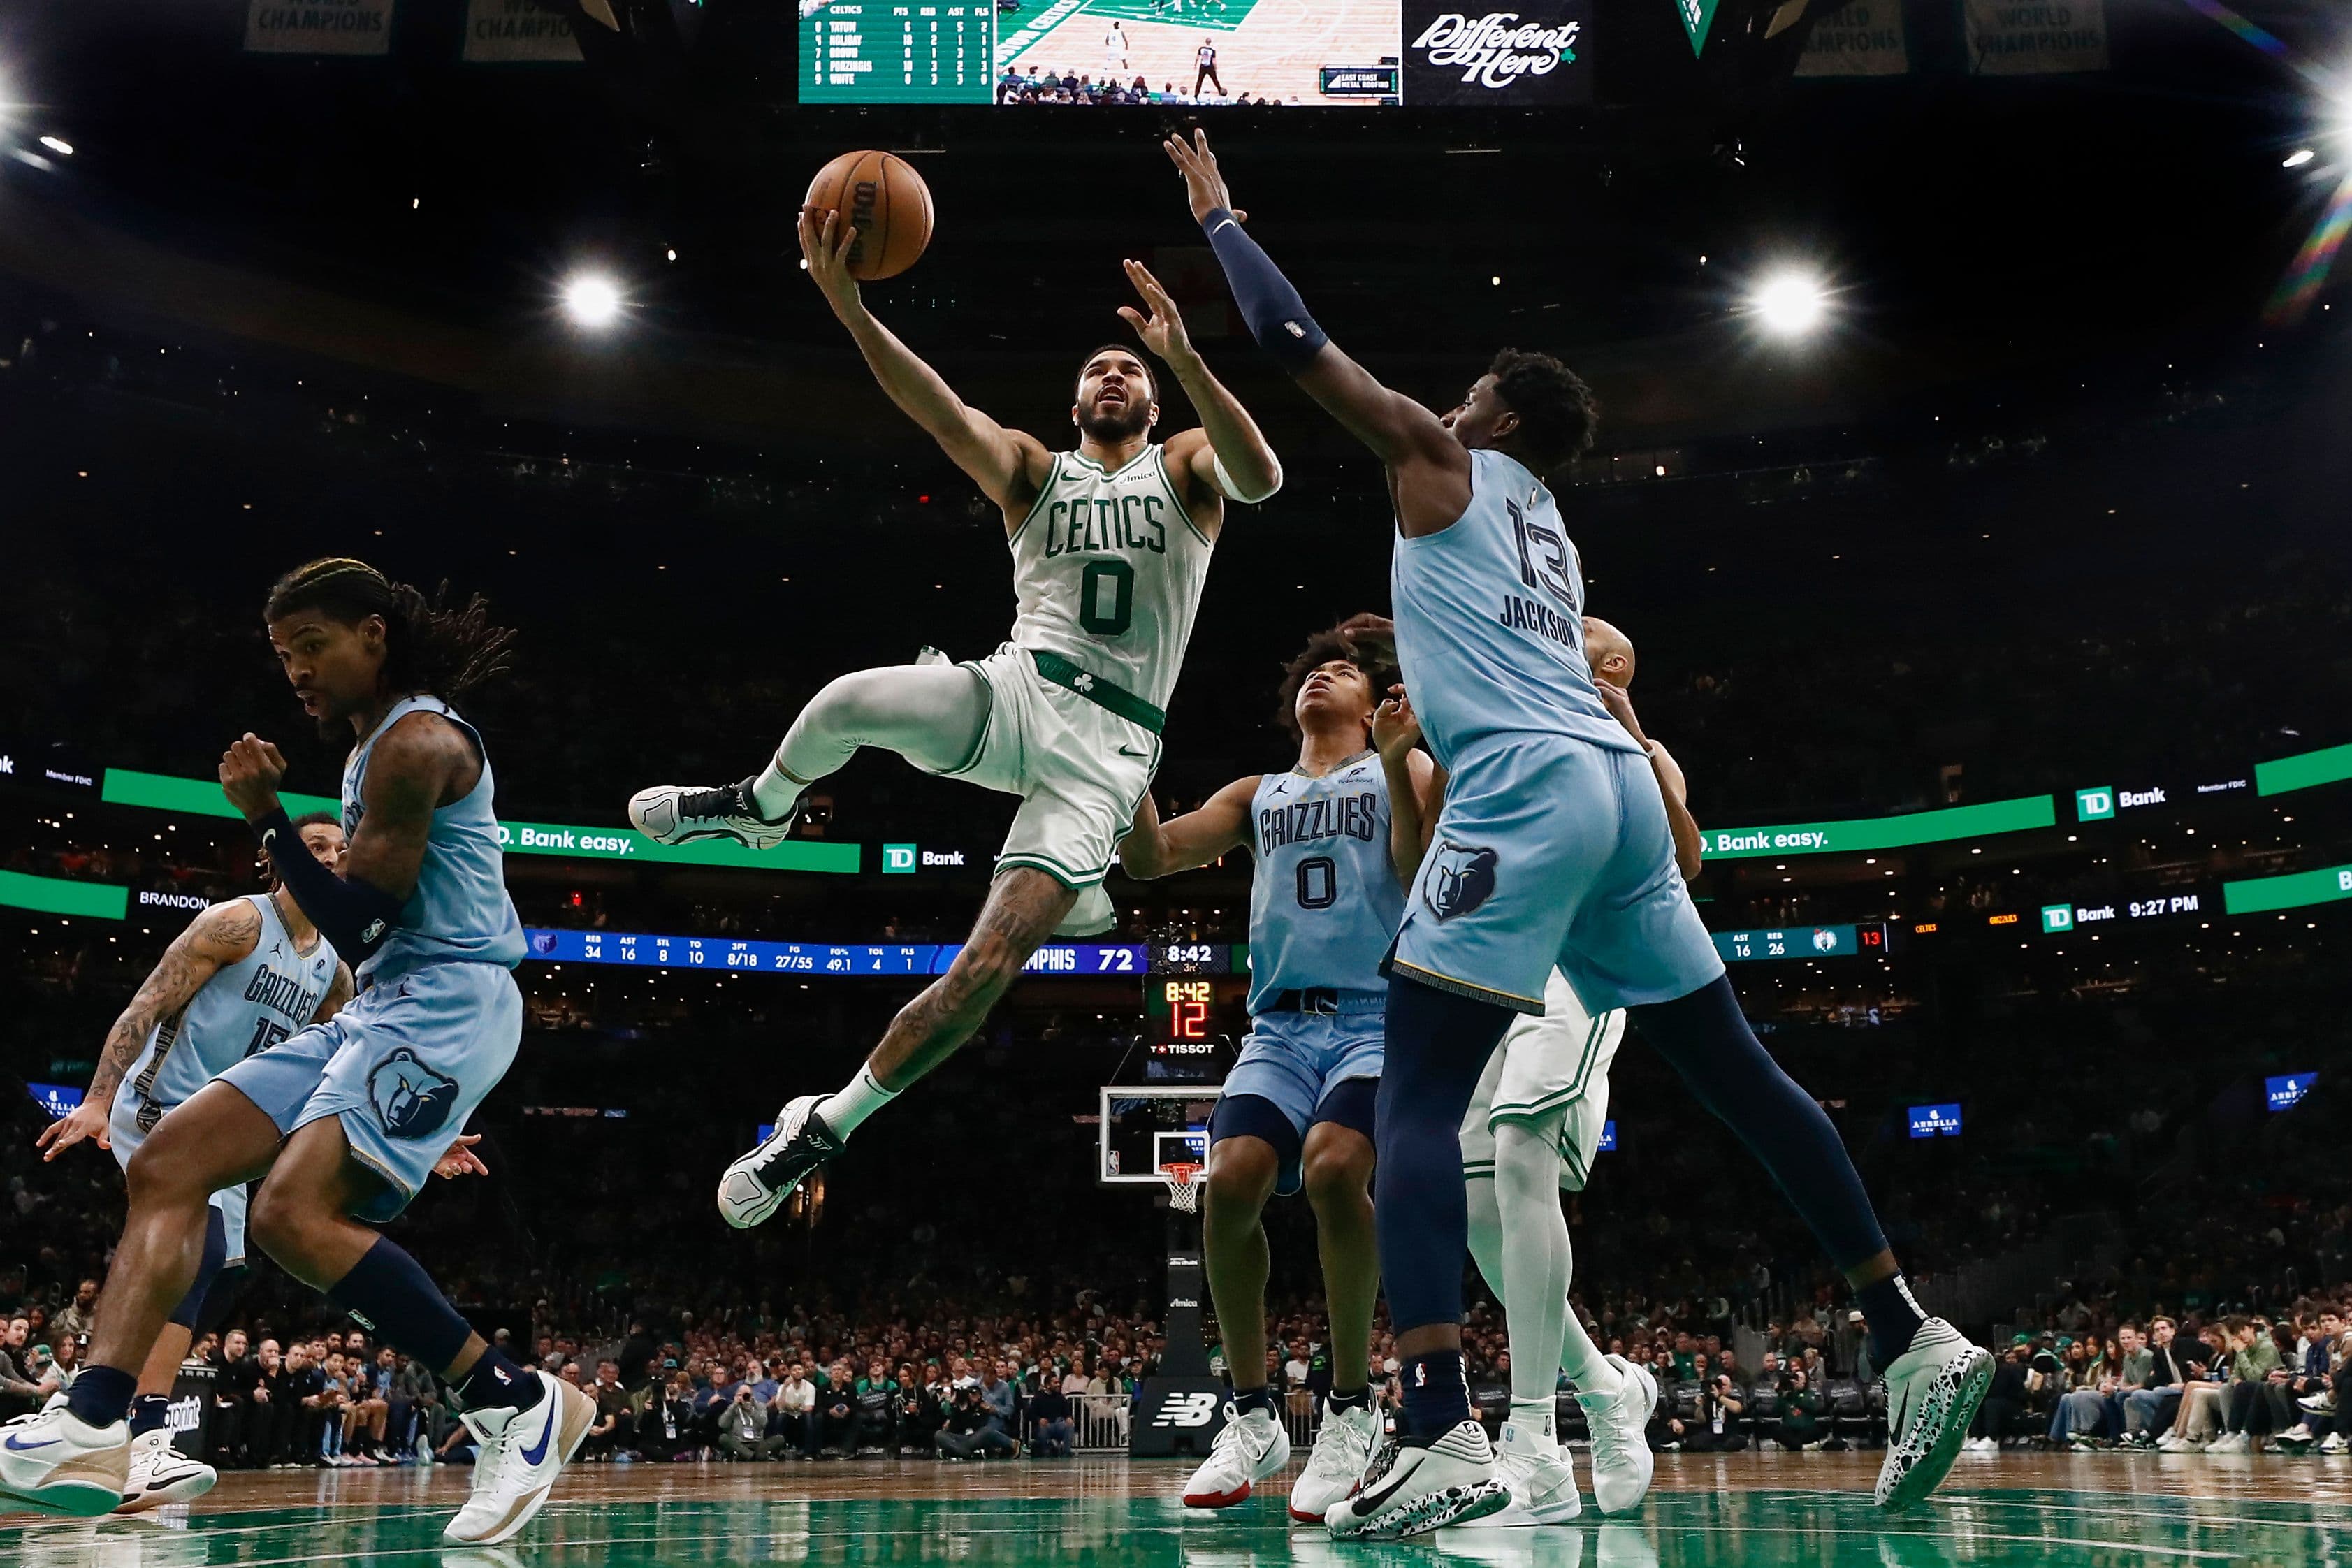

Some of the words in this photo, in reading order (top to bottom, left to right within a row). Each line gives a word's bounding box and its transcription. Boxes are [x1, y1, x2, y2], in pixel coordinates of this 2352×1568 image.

[258, 8, 382, 32] CHAMPIONS
[829, 5, 862, 15] CELTICS
[893, 7, 909, 17] PTS
[920, 7, 936, 17] REB
[947, 7, 964, 17] AST
[974, 7, 989, 17] FLS
[829, 20, 857, 33] TATUM
[957, 20, 964, 33] 5
[980, 20, 988, 33] 2
[1411, 13, 1581, 56] Different
[930, 34, 938, 46] 2
[957, 34, 963, 46] 1
[815, 47, 822, 59] 7
[931, 47, 937, 59] 1
[957, 47, 964, 59] 3
[982, 47, 987, 59] 1
[931, 60, 938, 72] 3
[957, 60, 964, 72] 2
[980, 60, 988, 72] 3
[1460, 47, 1560, 89] Here
[829, 73, 855, 85] WHITE
[931, 73, 938, 85] 3
[957, 73, 964, 85] 3
[1119, 470, 1156, 484] Amica
[1045, 495, 1166, 558] CELTICS
[1506, 497, 1578, 612] 13
[1079, 560, 1135, 635] 0
[1500, 595, 1578, 651] JACKSON
[2080, 792, 2110, 815] TD
[2119, 787, 2166, 808] Bank
[1259, 792, 1376, 857] GRIZZLIES
[521, 827, 575, 849] Bank
[579, 835, 634, 855] easy.
[1718, 832, 1771, 852] Bank
[1774, 832, 1828, 848] easy.
[885, 848, 913, 868] TD
[922, 850, 964, 866] Bank
[1296, 856, 1336, 910] 0
[140, 891, 210, 910] BRANDON
[2044, 908, 2070, 928] TD
[2077, 906, 2115, 922] Bank
[2130, 899, 2166, 917] 9:27
[2170, 895, 2199, 913] PM
[585, 935, 602, 943] REB
[656, 938, 670, 947] STL
[1733, 934, 1749, 942] AST
[1862, 932, 1880, 945] 13
[584, 945, 601, 958] 34
[621, 948, 636, 961] 16
[659, 950, 668, 962] 8
[689, 951, 704, 964] 10
[727, 953, 757, 967] 8/18
[775, 956, 813, 970] 27/55
[826, 959, 851, 971] 49.1
[872, 959, 881, 971] 4
[906, 958, 912, 971] 1
[1022, 948, 1076, 971] MPHIS
[1098, 948, 1133, 971] 72
[1168, 945, 1212, 962] 8:42
[1736, 945, 1751, 957] 16
[1769, 943, 1785, 955] 26
[1166, 982, 1210, 1002] 8:42
[1172, 1002, 1207, 1037] 12
[1168, 1045, 1214, 1054] TISSOT
[1912, 1118, 1959, 1128] ARBELLA
[1170, 1298, 1198, 1307] Amica
